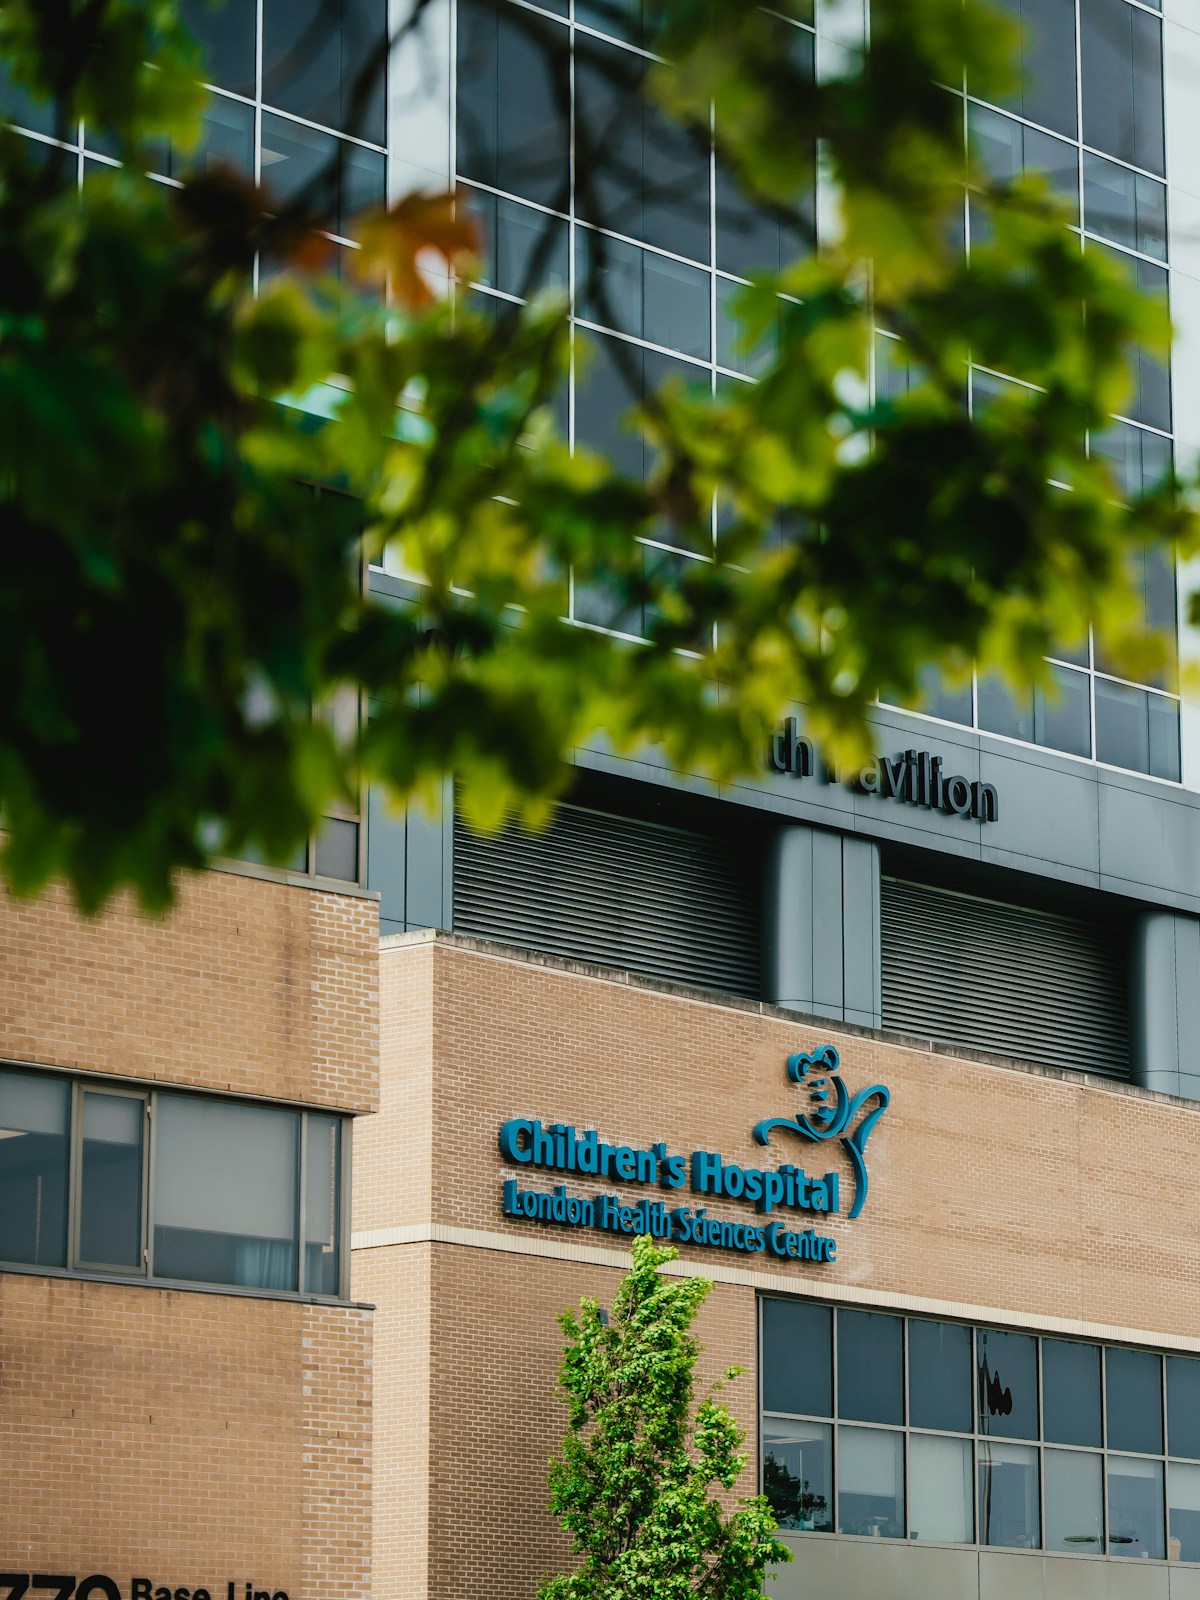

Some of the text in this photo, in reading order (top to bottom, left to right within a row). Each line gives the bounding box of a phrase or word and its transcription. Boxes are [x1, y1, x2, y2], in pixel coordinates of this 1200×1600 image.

[827, 748, 999, 823] avilion
[501, 1118, 840, 1213] Children's Hospital
[503, 1179, 837, 1263] London Health Sciences Centre
